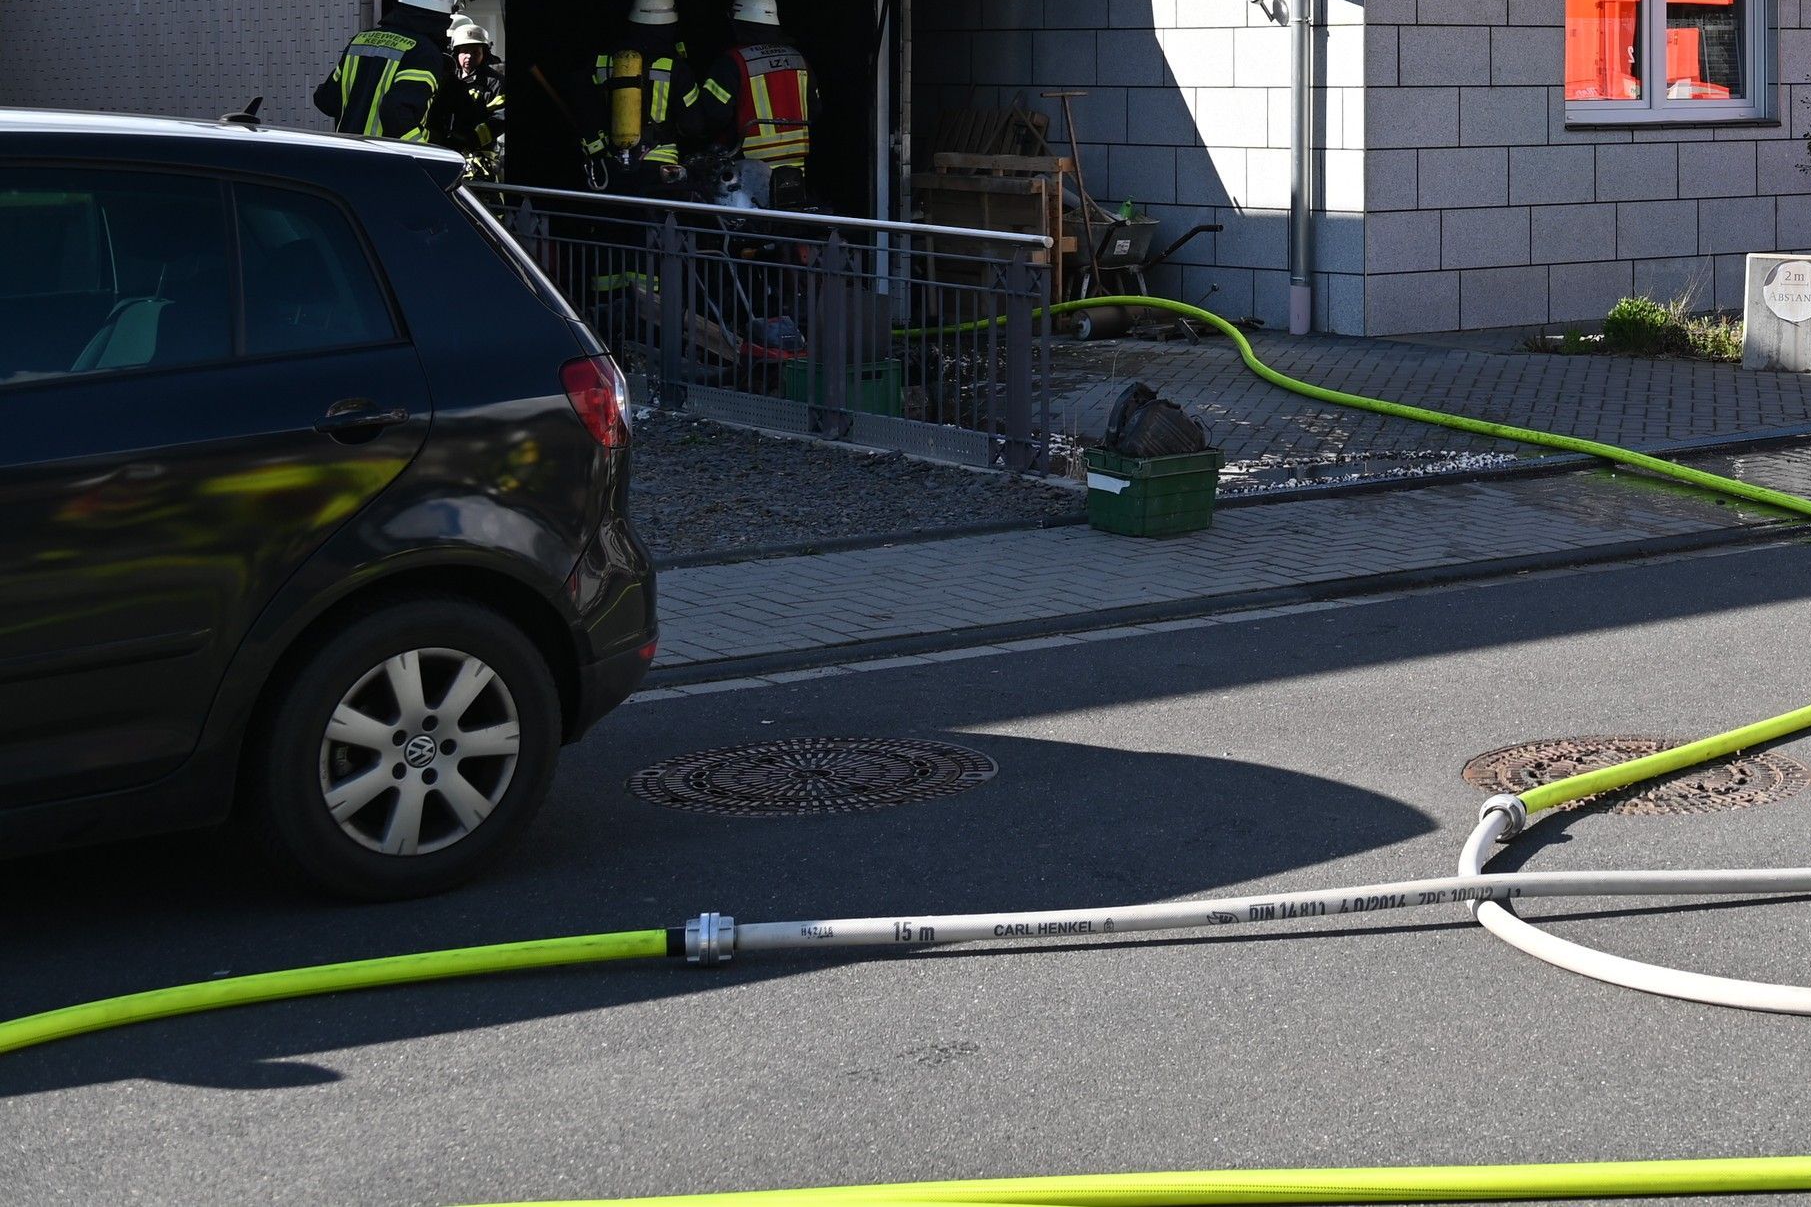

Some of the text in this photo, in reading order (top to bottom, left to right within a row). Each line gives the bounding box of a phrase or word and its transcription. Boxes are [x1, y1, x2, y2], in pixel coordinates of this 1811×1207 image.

[769, 59, 782, 69] LZ
[1784, 270, 1806, 282] 2 m
[893, 921, 912, 943] 15
[918, 925, 935, 941] m
[993, 923, 1034, 937] CARL
[1037, 920, 1097, 934] HENKEL
[1250, 903, 1275, 921] DIN
